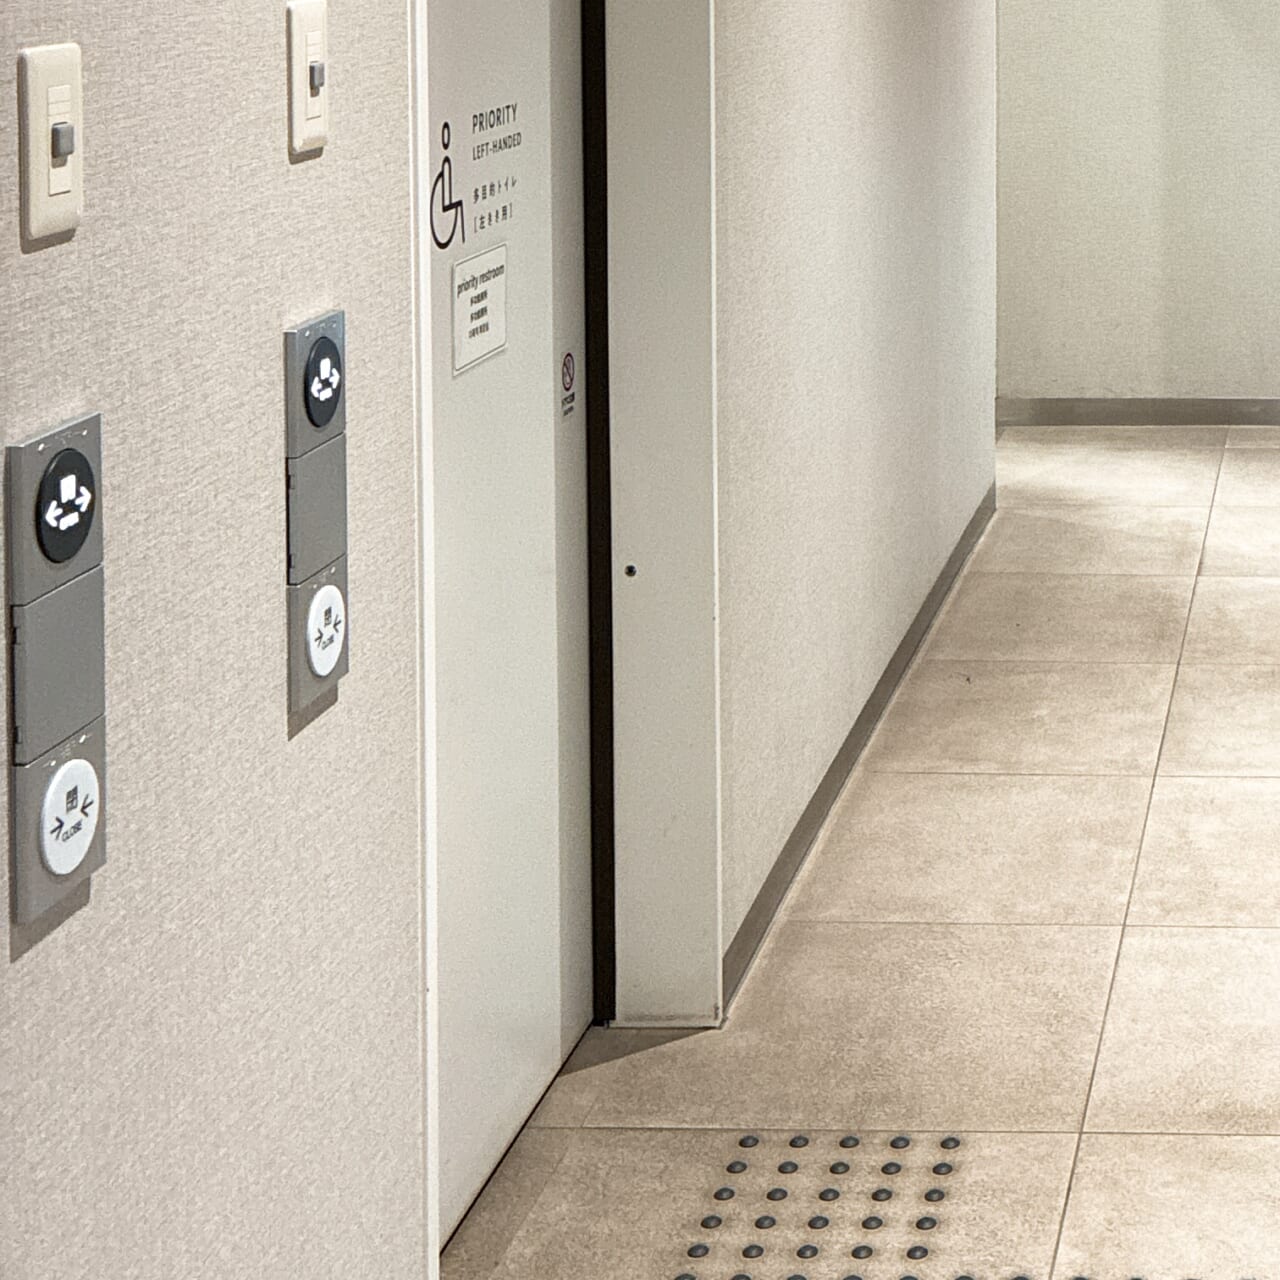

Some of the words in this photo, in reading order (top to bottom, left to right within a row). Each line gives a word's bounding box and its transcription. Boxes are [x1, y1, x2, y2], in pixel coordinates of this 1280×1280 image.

[472, 103, 518, 134] PRIORITY
[472, 131, 522, 161] LEFT-HANDED
[457, 274, 479, 299] priority
